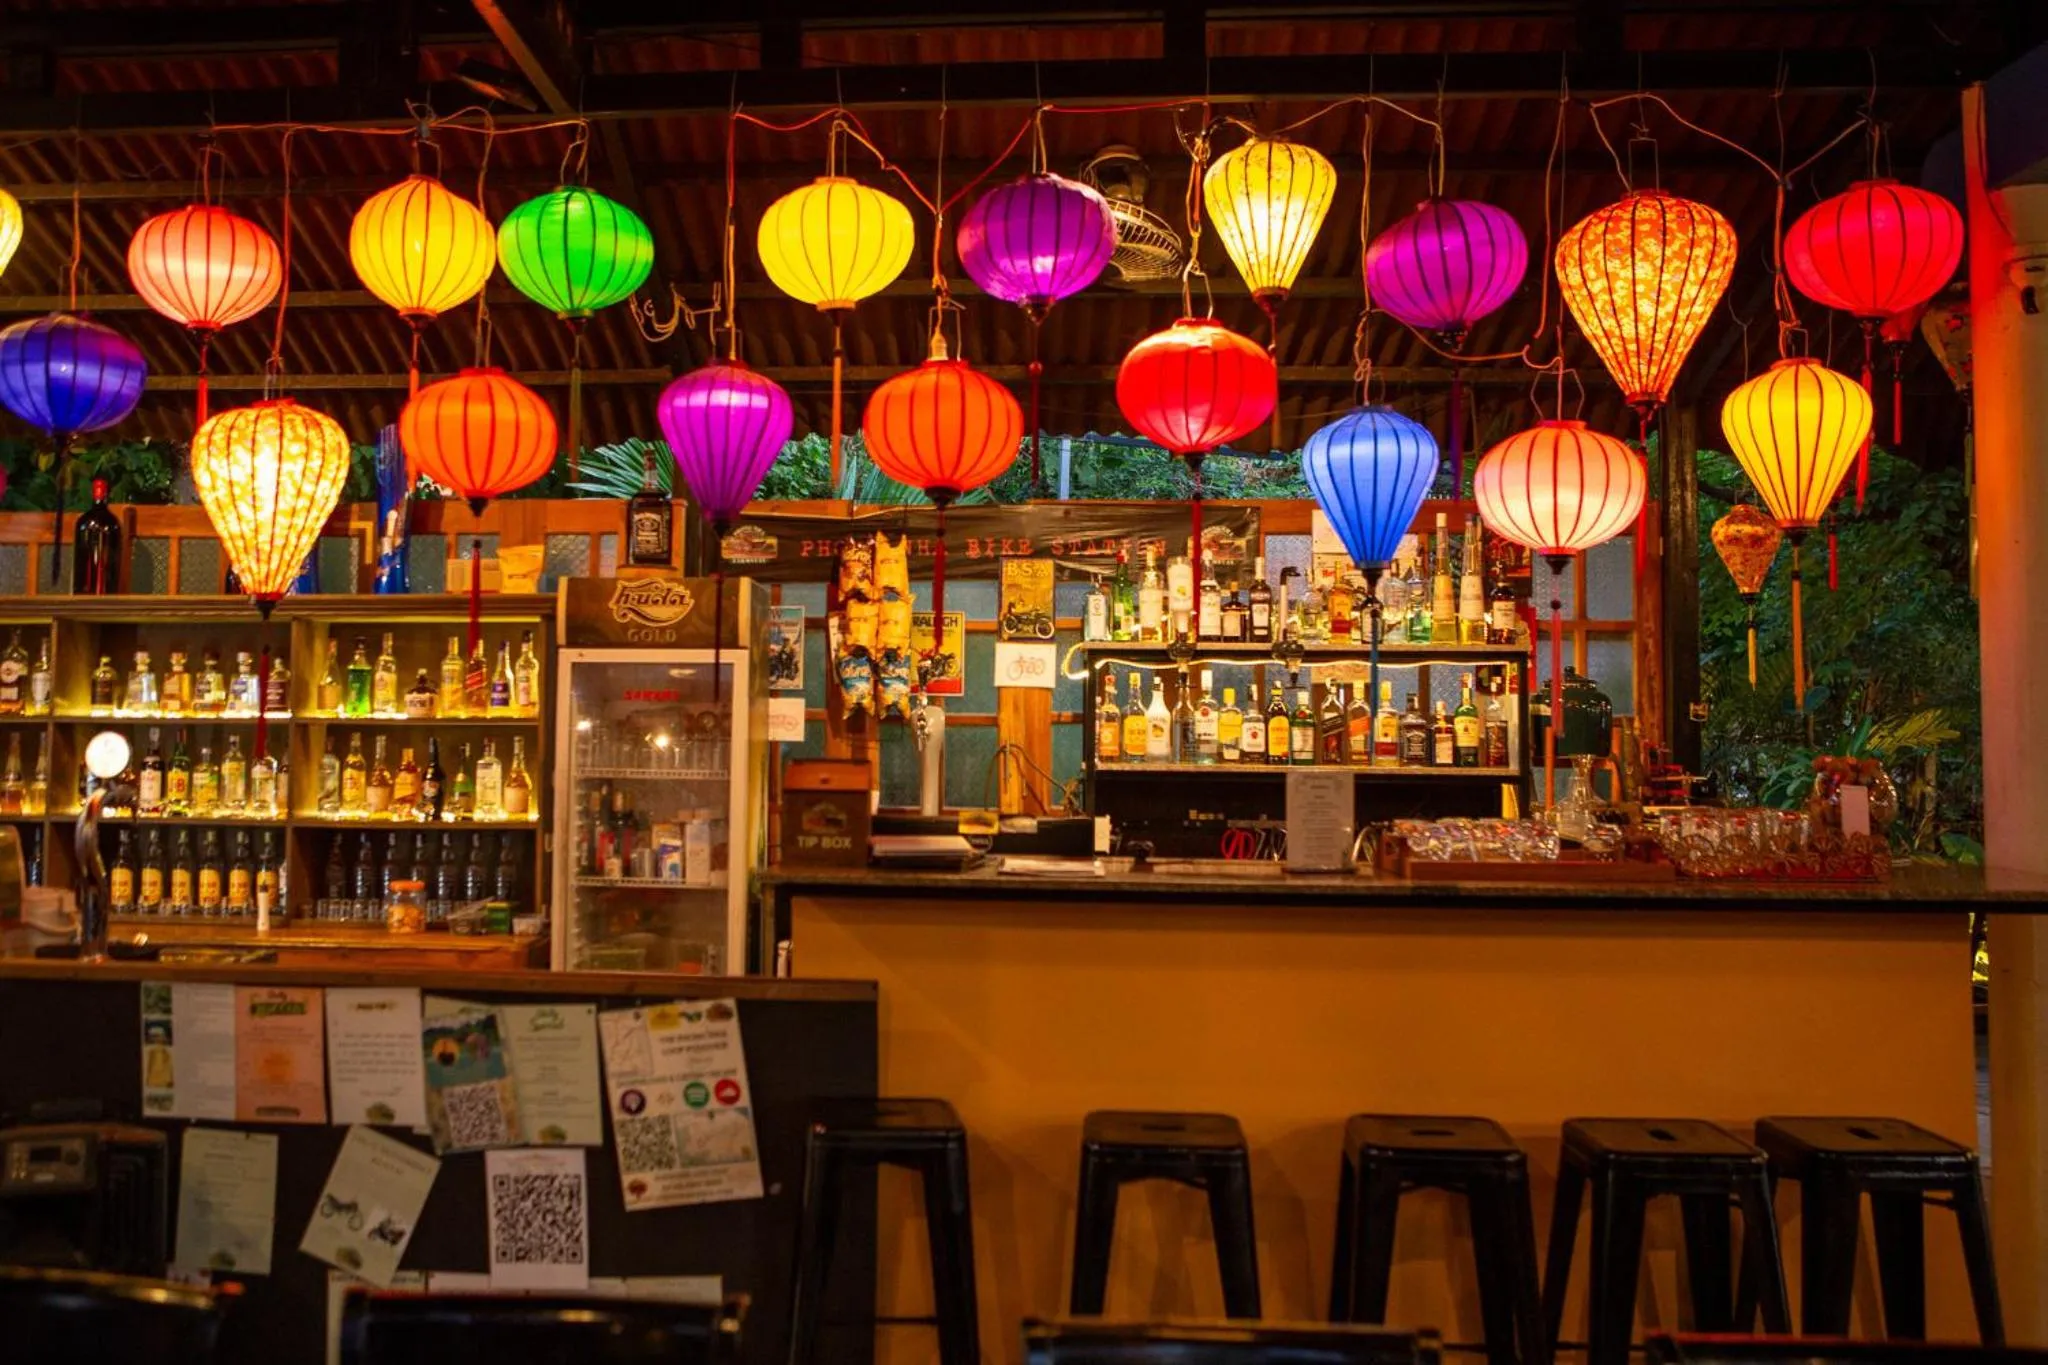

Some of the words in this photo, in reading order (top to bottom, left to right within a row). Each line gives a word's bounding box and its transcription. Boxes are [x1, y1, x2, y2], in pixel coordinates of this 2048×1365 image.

[965, 536, 1033, 558] BIKE
[912, 615, 959, 628] RALGH
[628, 629, 676, 641] GOLD
[797, 835, 819, 848] TIP
[821, 835, 852, 849] BOX
